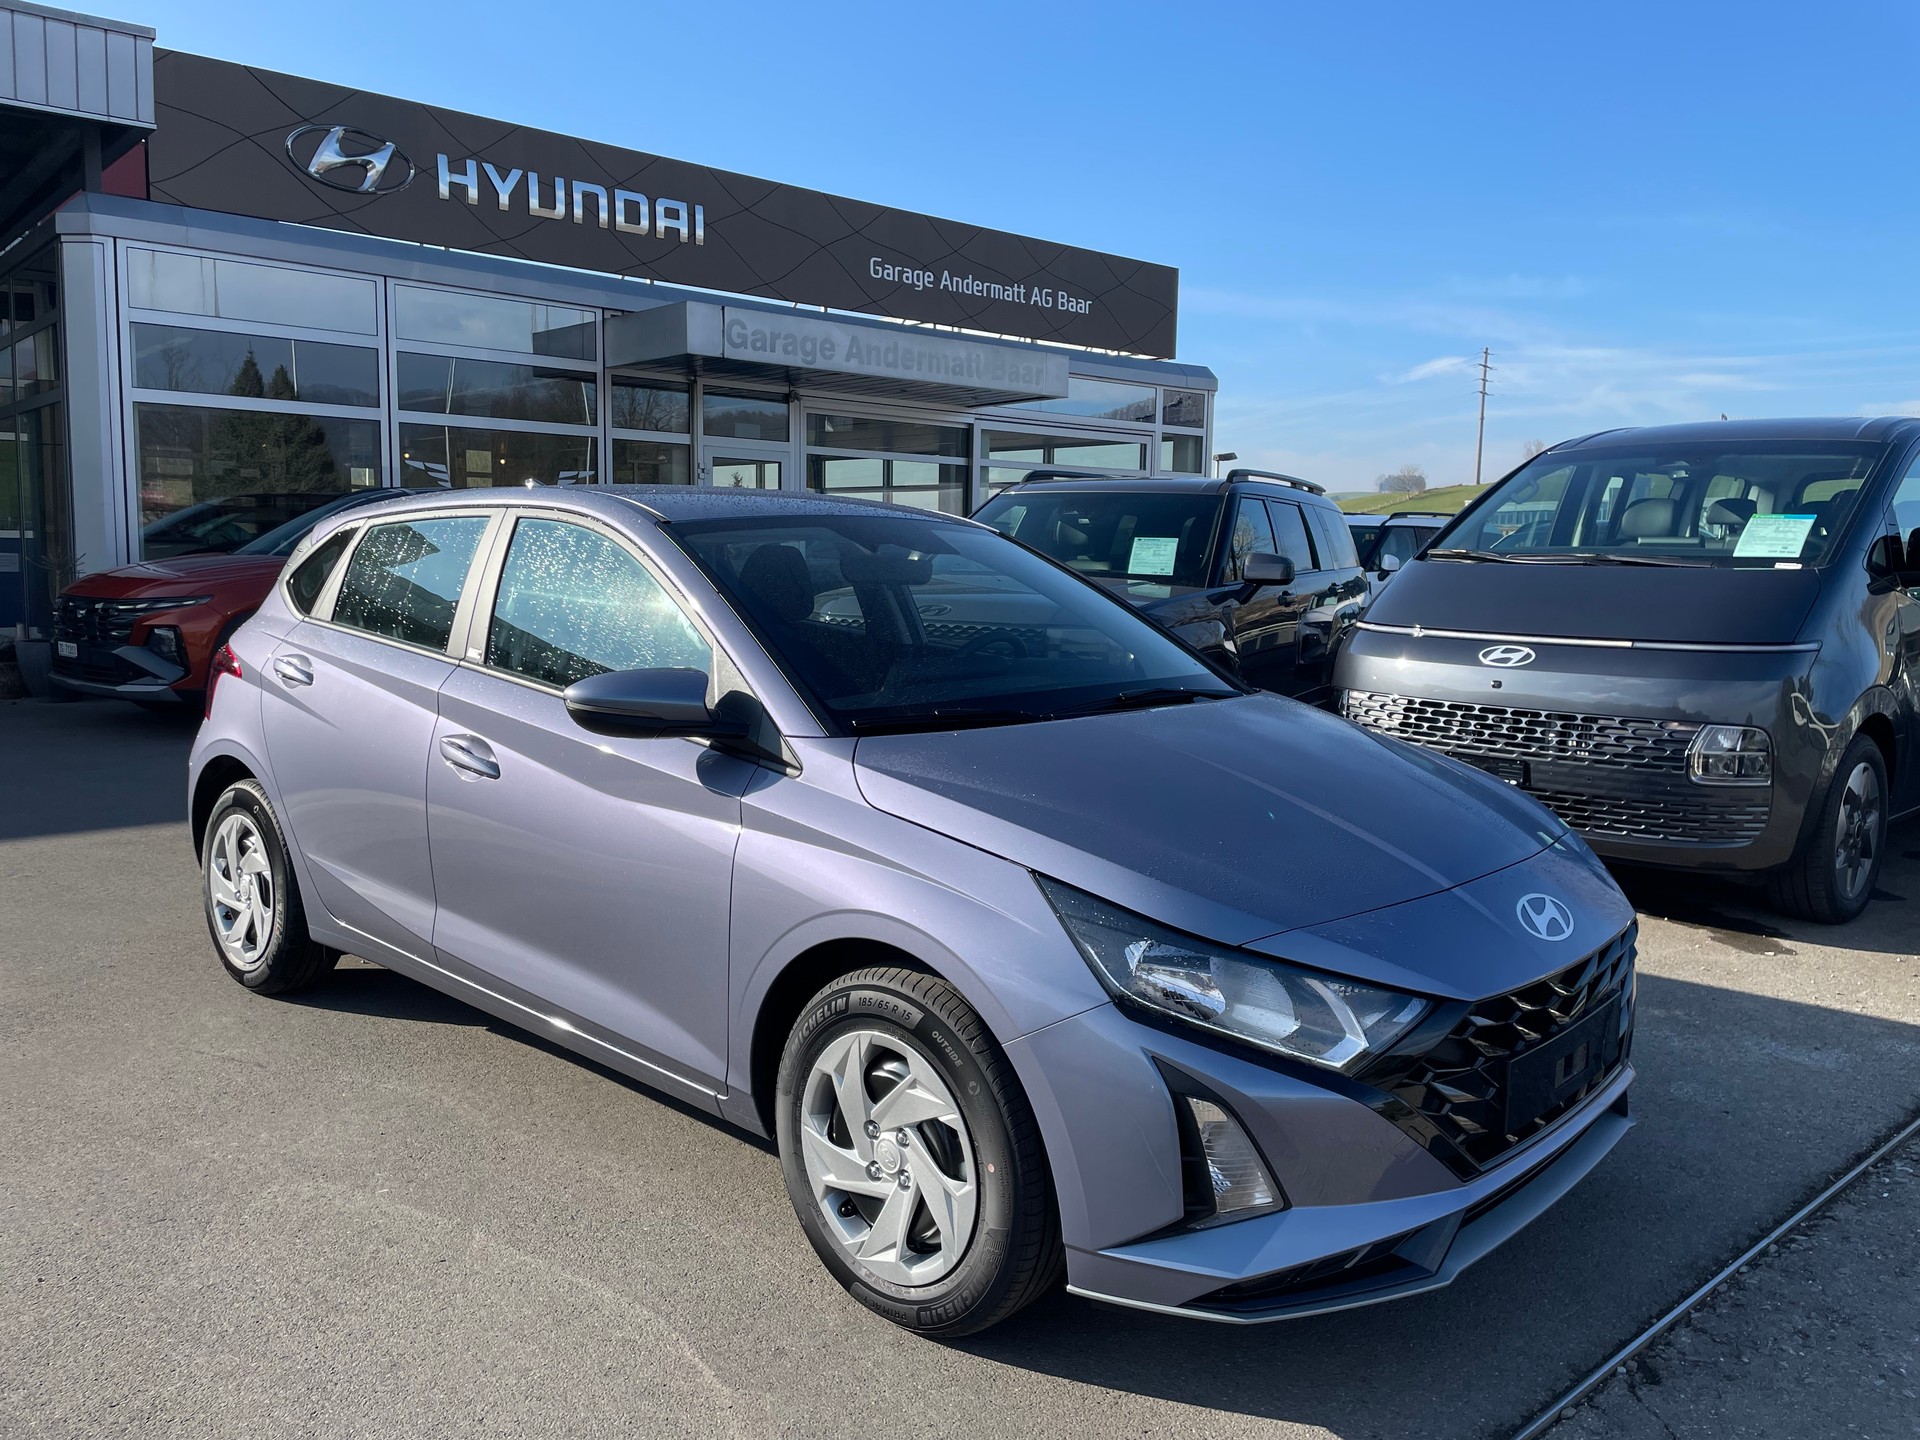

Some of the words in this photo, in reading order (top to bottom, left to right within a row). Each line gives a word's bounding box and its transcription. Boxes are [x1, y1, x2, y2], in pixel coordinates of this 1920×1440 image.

[436, 153, 705, 247] HYUNDAI
[869, 256, 935, 291] Garage
[940, 270, 1026, 304] Andermatt
[1030, 286, 1053, 309] AG
[1057, 291, 1093, 315] Baar
[725, 318, 836, 366] Garage
[844, 335, 983, 380] Andermatt
[991, 352, 1045, 386] Baar
[790, 996, 847, 1056] MICHELIN
[858, 996, 889, 1010] 185/65
[891, 1003, 898, 1015] R
[901, 1009, 913, 1022] 15
[931, 1030, 964, 1067] OUTSIDE
[919, 1265, 990, 1325] MICHELIN
